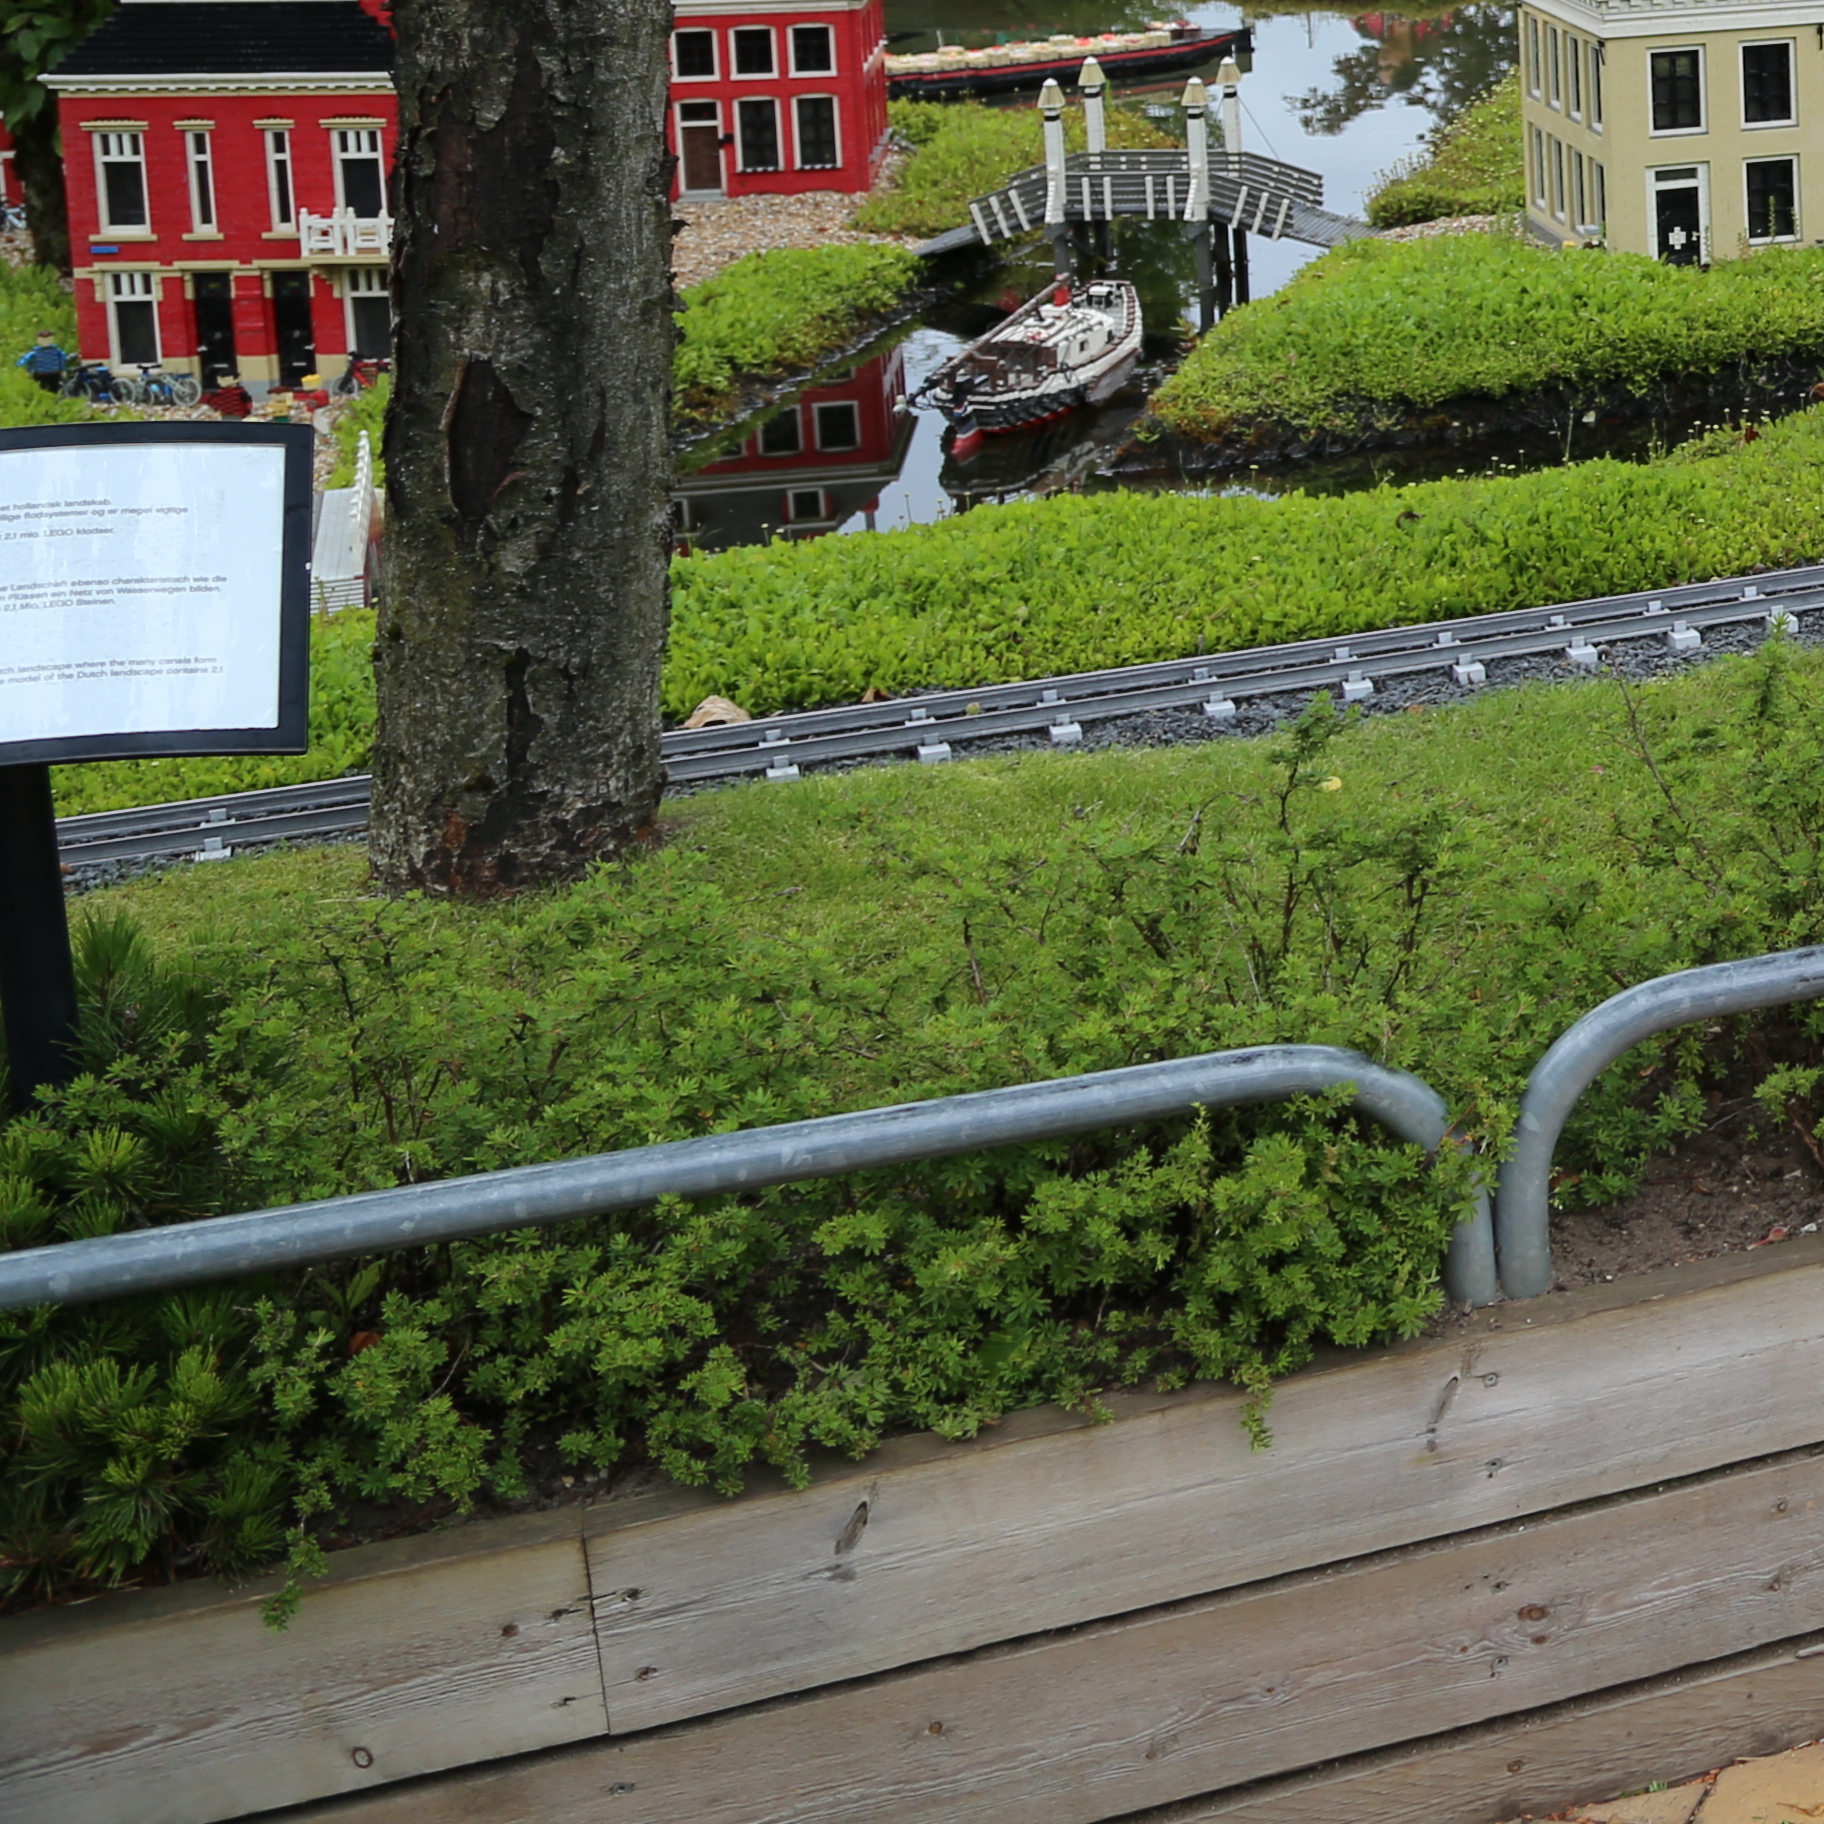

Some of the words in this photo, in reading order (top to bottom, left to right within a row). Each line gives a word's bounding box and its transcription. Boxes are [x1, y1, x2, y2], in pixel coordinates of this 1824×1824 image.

[13, 501, 61, 511] hollandsk
[91, 509, 105, 517] og
[121, 507, 153, 516] meget
[155, 506, 188, 515] vigtige
[44, 528, 74, 537] LEGO
[11, 580, 68, 591] Landschaft
[70, 579, 109, 587] ebenso
[212, 575, 228, 583] die
[69, 588, 93, 596] Netz
[117, 586, 187, 595] Wasserwegen
[43, 599, 74, 608] LEGO
[17, 663, 73, 673] landscape
[75, 660, 107, 669] where
[109, 658, 126, 667] the
[128, 659, 156, 667] many
[158, 656, 192, 665] canals
[194, 656, 217, 664] form
[8, 674, 41, 684] model
[44, 672, 55, 681] of
[57, 672, 74, 680] the
[76, 670, 107, 679] Dutch
[110, 668, 164, 677] landscape
[166, 666, 209, 675] contains
